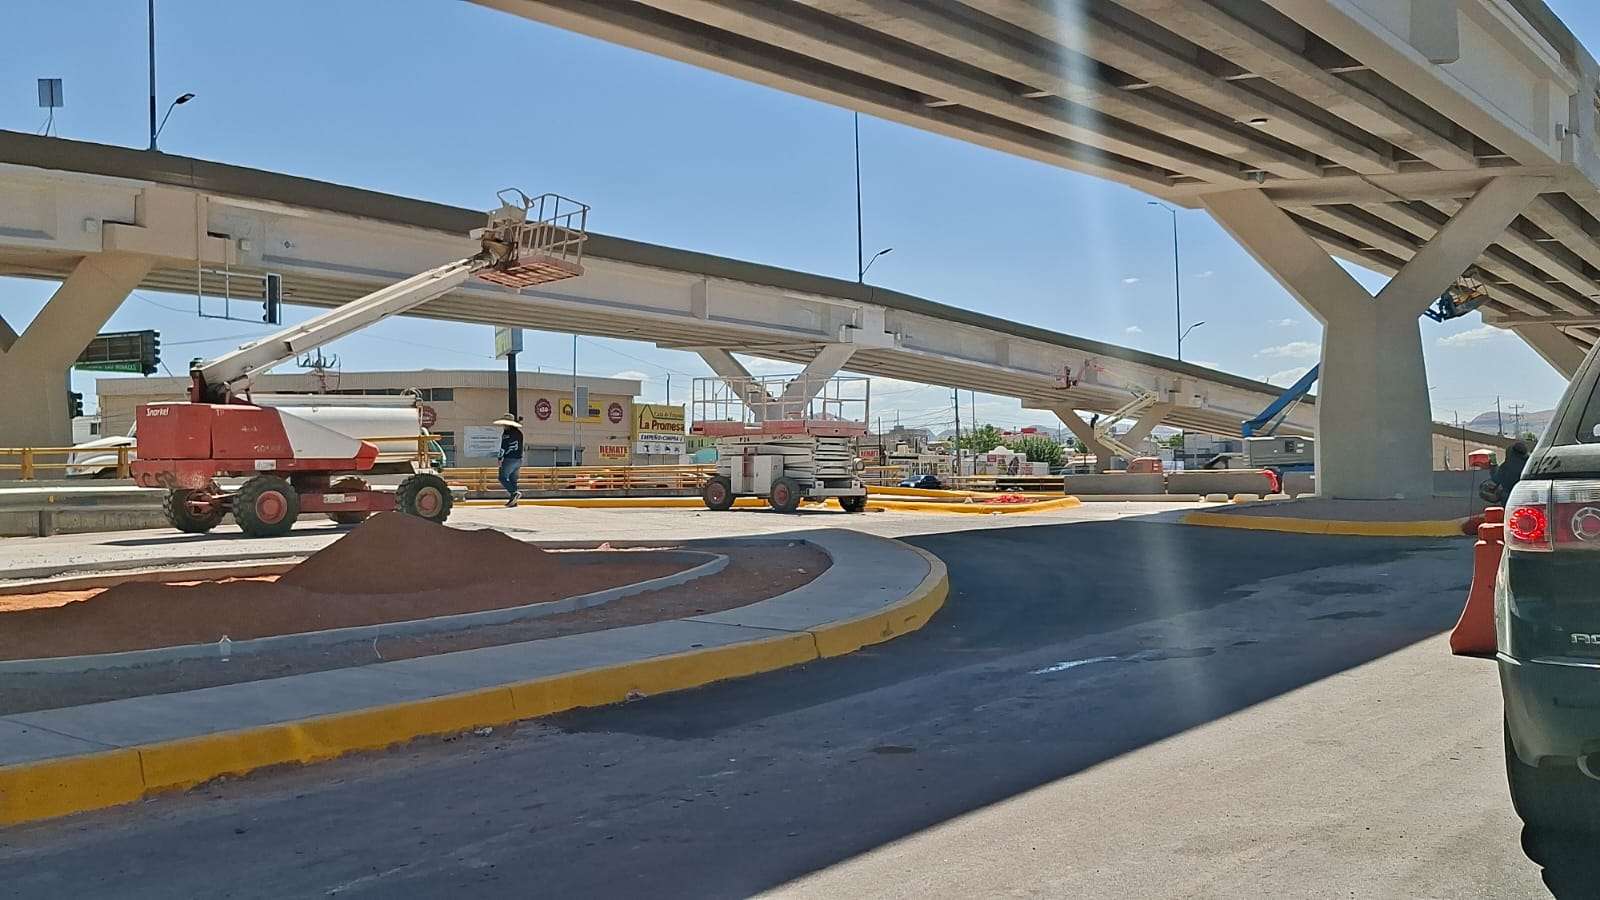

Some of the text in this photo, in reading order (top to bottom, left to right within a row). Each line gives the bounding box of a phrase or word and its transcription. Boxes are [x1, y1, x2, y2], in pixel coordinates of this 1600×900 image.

[639, 415, 685, 432] La Promesa
[599, 445, 628, 454] REMATE
